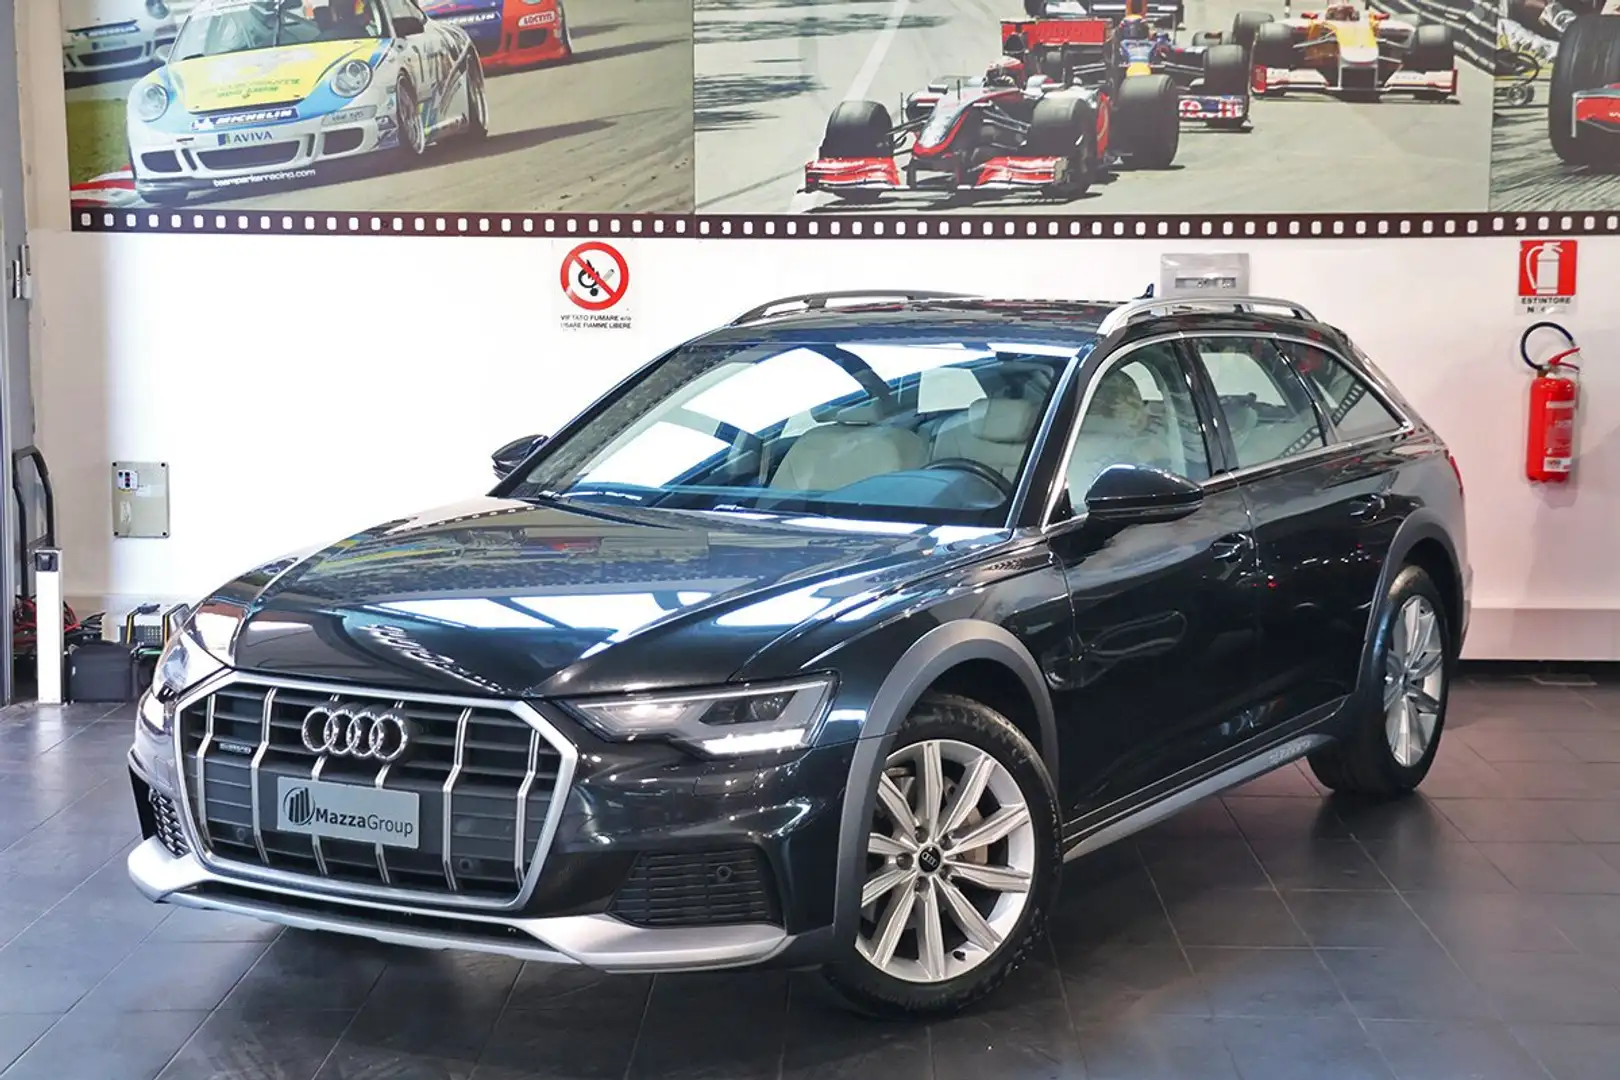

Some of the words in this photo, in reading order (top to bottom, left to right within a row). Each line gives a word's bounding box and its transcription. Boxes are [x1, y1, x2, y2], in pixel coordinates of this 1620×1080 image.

[216, 109, 293, 124] MICHELIN
[233, 130, 273, 144] AVIVA
[213, 169, 316, 187] teamparkerracing.com
[1521, 296, 1571, 305] ESTINTORE
[590, 314, 619, 322] FUMARE
[315, 807, 414, 837] MazzaGroup
